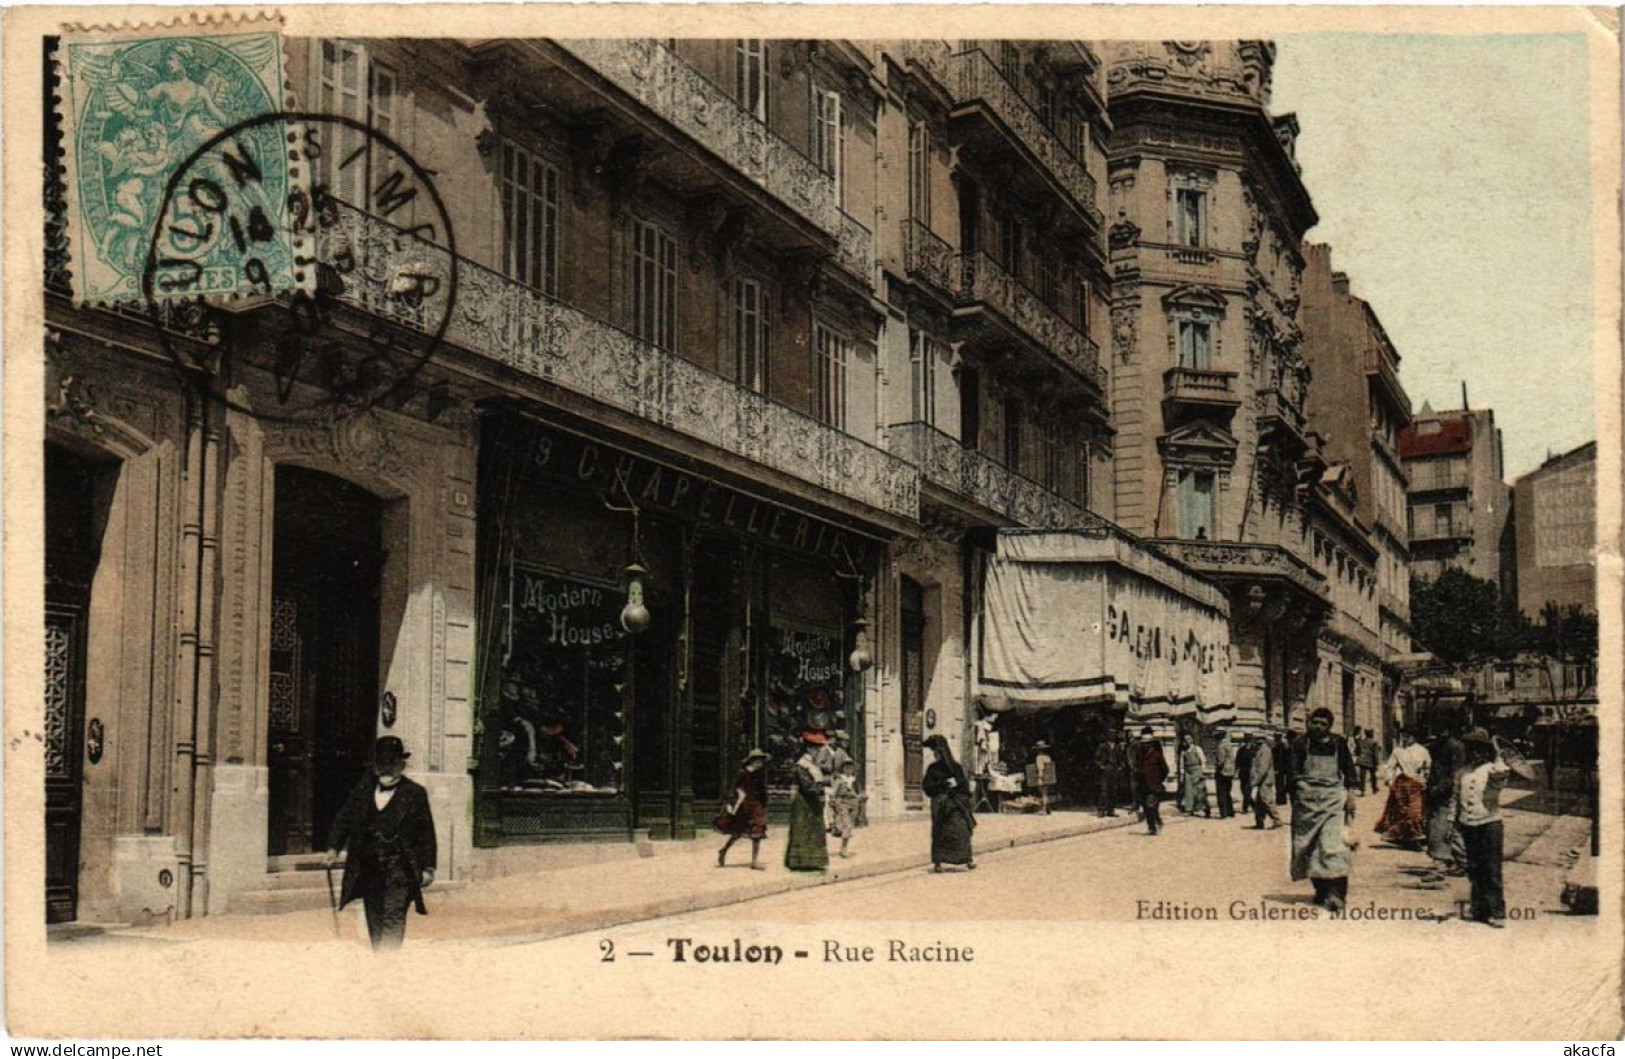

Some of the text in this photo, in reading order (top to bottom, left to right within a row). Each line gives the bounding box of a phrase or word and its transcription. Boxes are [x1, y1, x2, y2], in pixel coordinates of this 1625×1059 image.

[577, 443, 845, 558] CHAPELLERIE
[519, 574, 603, 614] Modern
[780, 630, 832, 657] Modern
